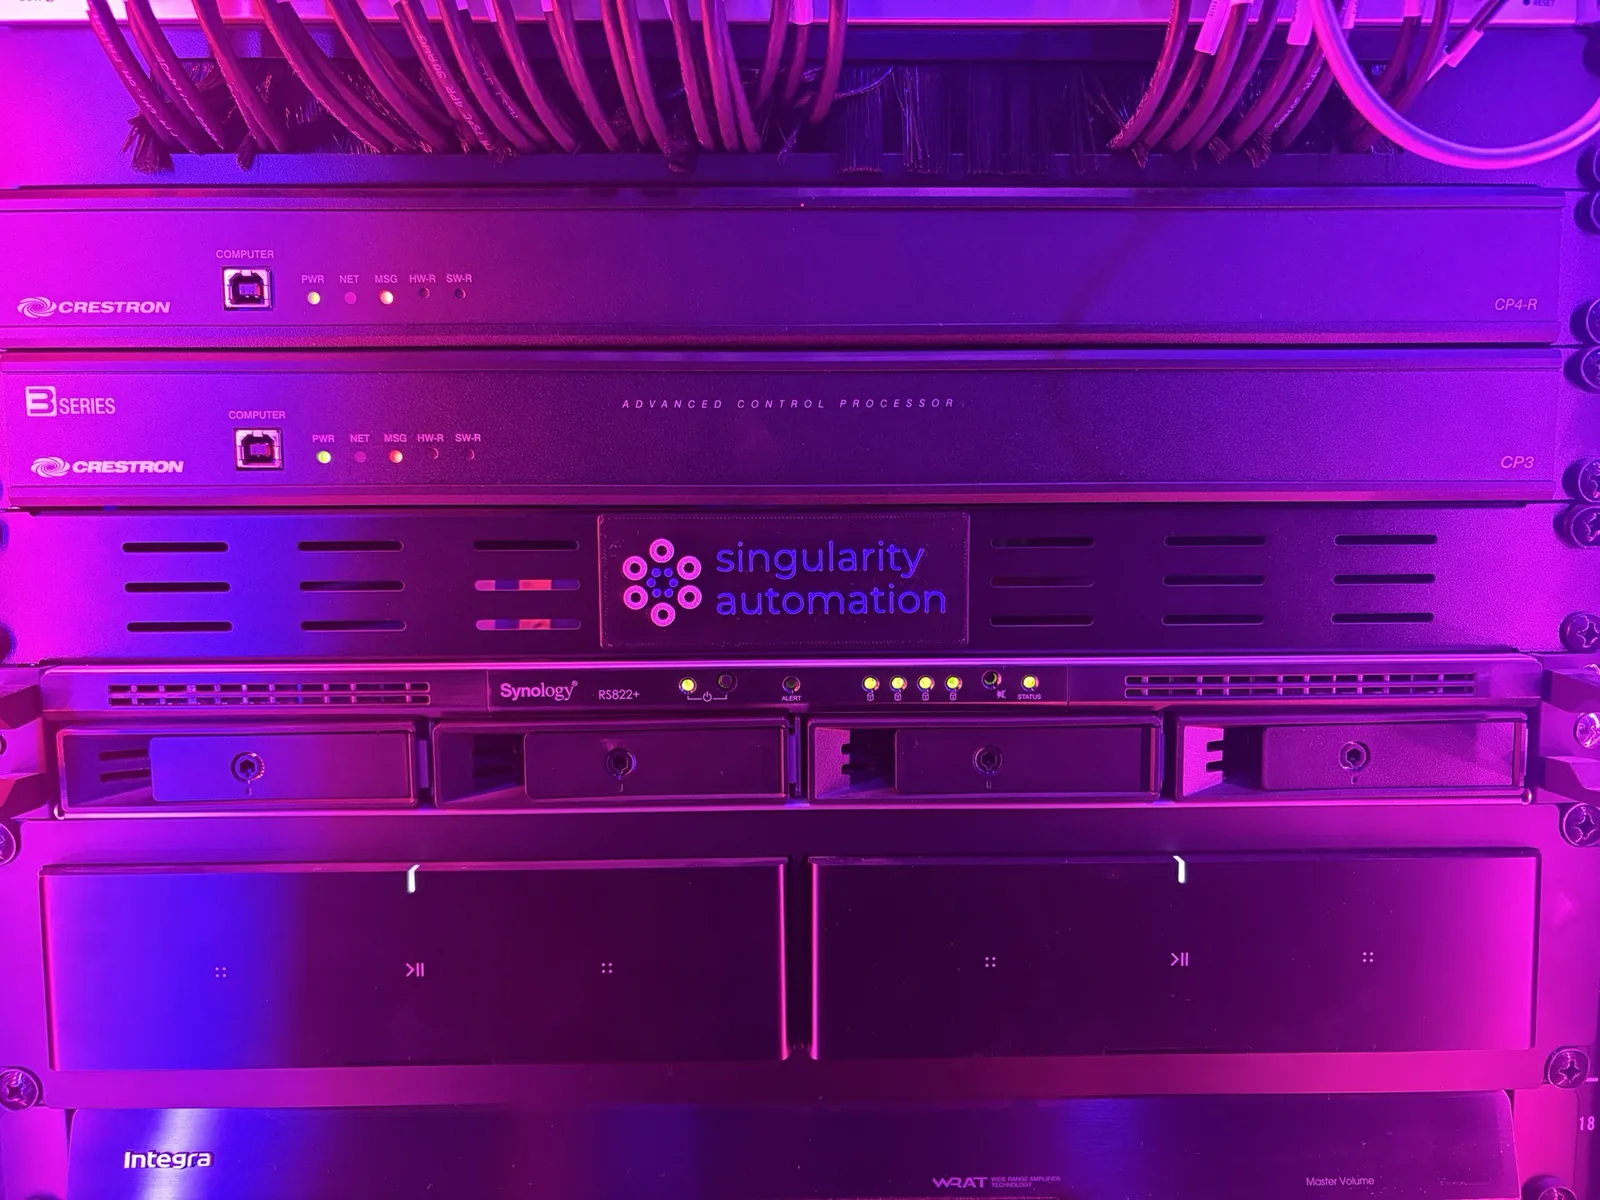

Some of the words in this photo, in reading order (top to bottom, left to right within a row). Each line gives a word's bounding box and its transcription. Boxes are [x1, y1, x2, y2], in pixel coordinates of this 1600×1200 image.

[215, 249, 275, 259] COMPUTER
[301, 274, 325, 284] PWR
[339, 274, 360, 284] NET
[374, 274, 398, 284] MSG
[408, 274, 436, 284] HW-R
[446, 274, 473, 284] SW-R
[58, 301, 171, 314] CRESTRON
[1494, 297, 1538, 311] CP4-R
[59, 397, 116, 415] SERIES
[621, 399, 723, 409] ADVANCED
[737, 398, 825, 409] CONTROL
[839, 398, 955, 409] PROCESSOR
[228, 410, 286, 420] COMPUTER
[311, 433, 336, 444] PWR
[349, 433, 371, 443] NET
[383, 433, 408, 443] MSG
[417, 433, 445, 443] HW-R
[454, 433, 482, 443] SW-R
[72, 460, 184, 474] CRESTRON
[1500, 455, 1535, 469] CP3
[716, 540, 926, 580] singularity
[716, 582, 947, 616] automation
[598, 688, 641, 701] RS822+
[781, 694, 802, 702] ALERT
[1579, 1115, 1595, 1131] 18
[124, 1151, 213, 1170] Integra
[931, 1176, 989, 1189] WRAT
[1305, 1176, 1337, 1187] Master
[1339, 1176, 1375, 1187] Volume
